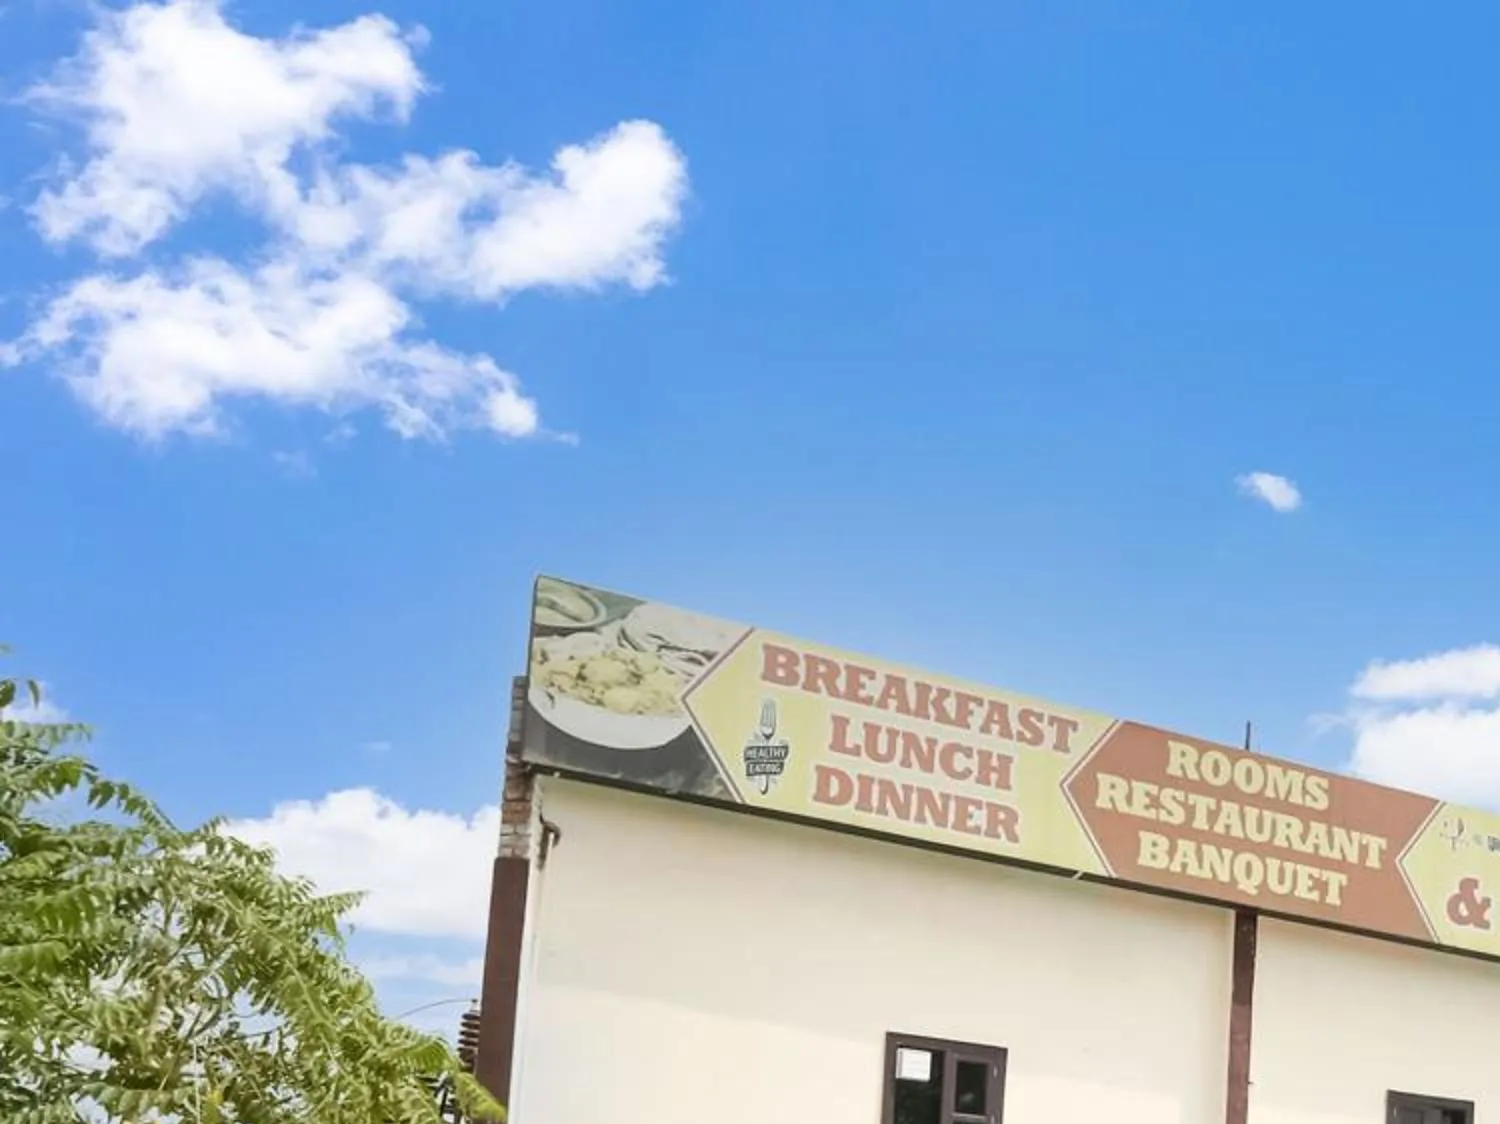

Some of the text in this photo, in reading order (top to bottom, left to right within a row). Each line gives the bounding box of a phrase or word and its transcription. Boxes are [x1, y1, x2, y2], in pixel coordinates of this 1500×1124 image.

[760, 642, 1079, 754] BREAKFAST
[828, 715, 1015, 791] LUNCH
[1167, 739, 1330, 811] ROOMS
[812, 764, 1020, 845] DINNER
[1095, 772, 1388, 870] RESTAURANT
[1137, 831, 1347, 906] BANQUET
[1446, 877, 1491, 931] &
